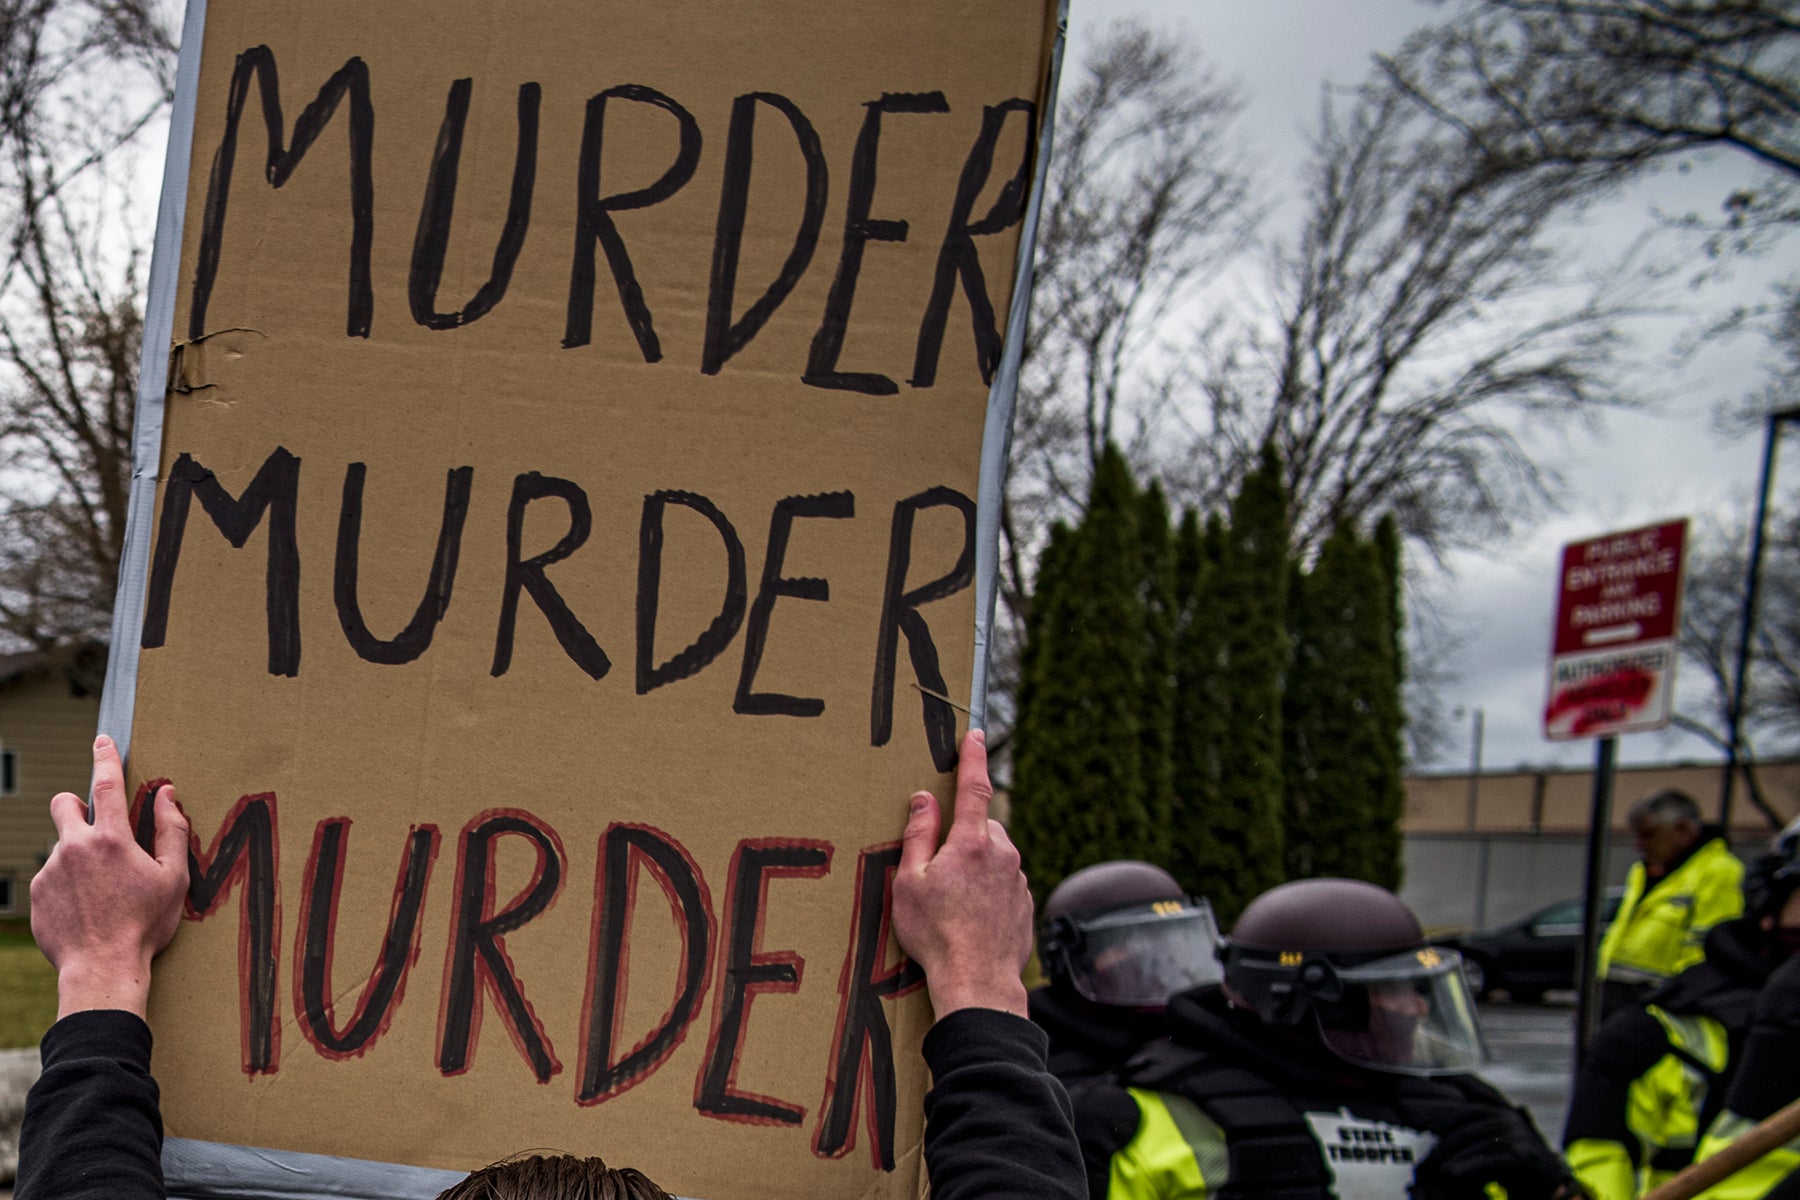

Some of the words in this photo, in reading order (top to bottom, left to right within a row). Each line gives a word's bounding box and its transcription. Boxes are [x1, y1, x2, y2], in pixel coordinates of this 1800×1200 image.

[188, 44, 1037, 396] MURDER
[141, 445, 977, 774] MURDER
[130, 777, 925, 1172] MURDER
[1339, 1126, 1394, 1143] STATE
[1326, 1143, 1414, 1164] TROOPER
